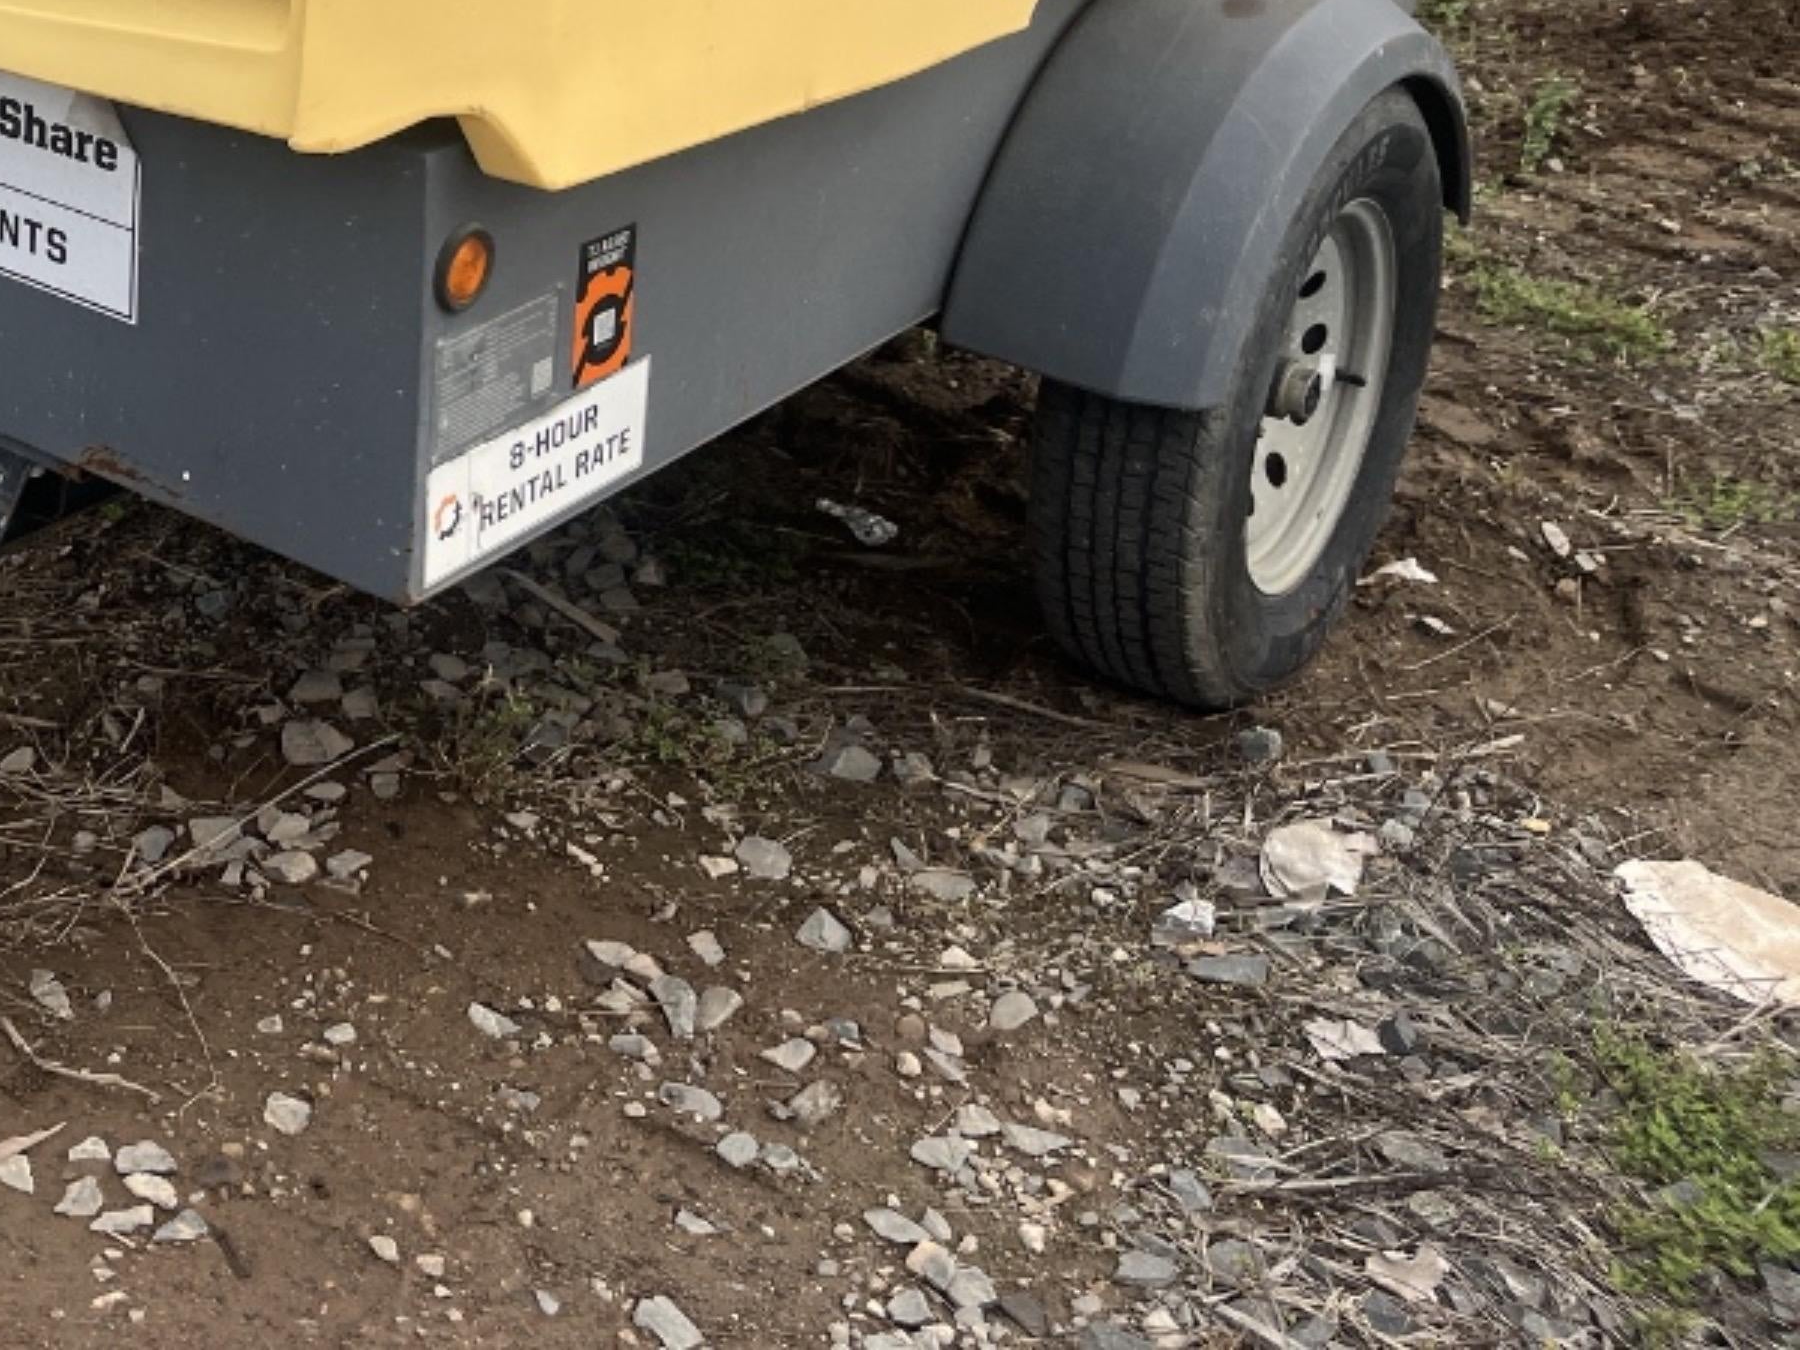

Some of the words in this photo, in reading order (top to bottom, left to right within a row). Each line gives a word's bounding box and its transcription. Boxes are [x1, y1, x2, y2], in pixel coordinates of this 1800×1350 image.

[509, 403, 599, 470] 8-HOUR
[478, 464, 567, 532] RENTAL
[574, 428, 631, 478] RATE
